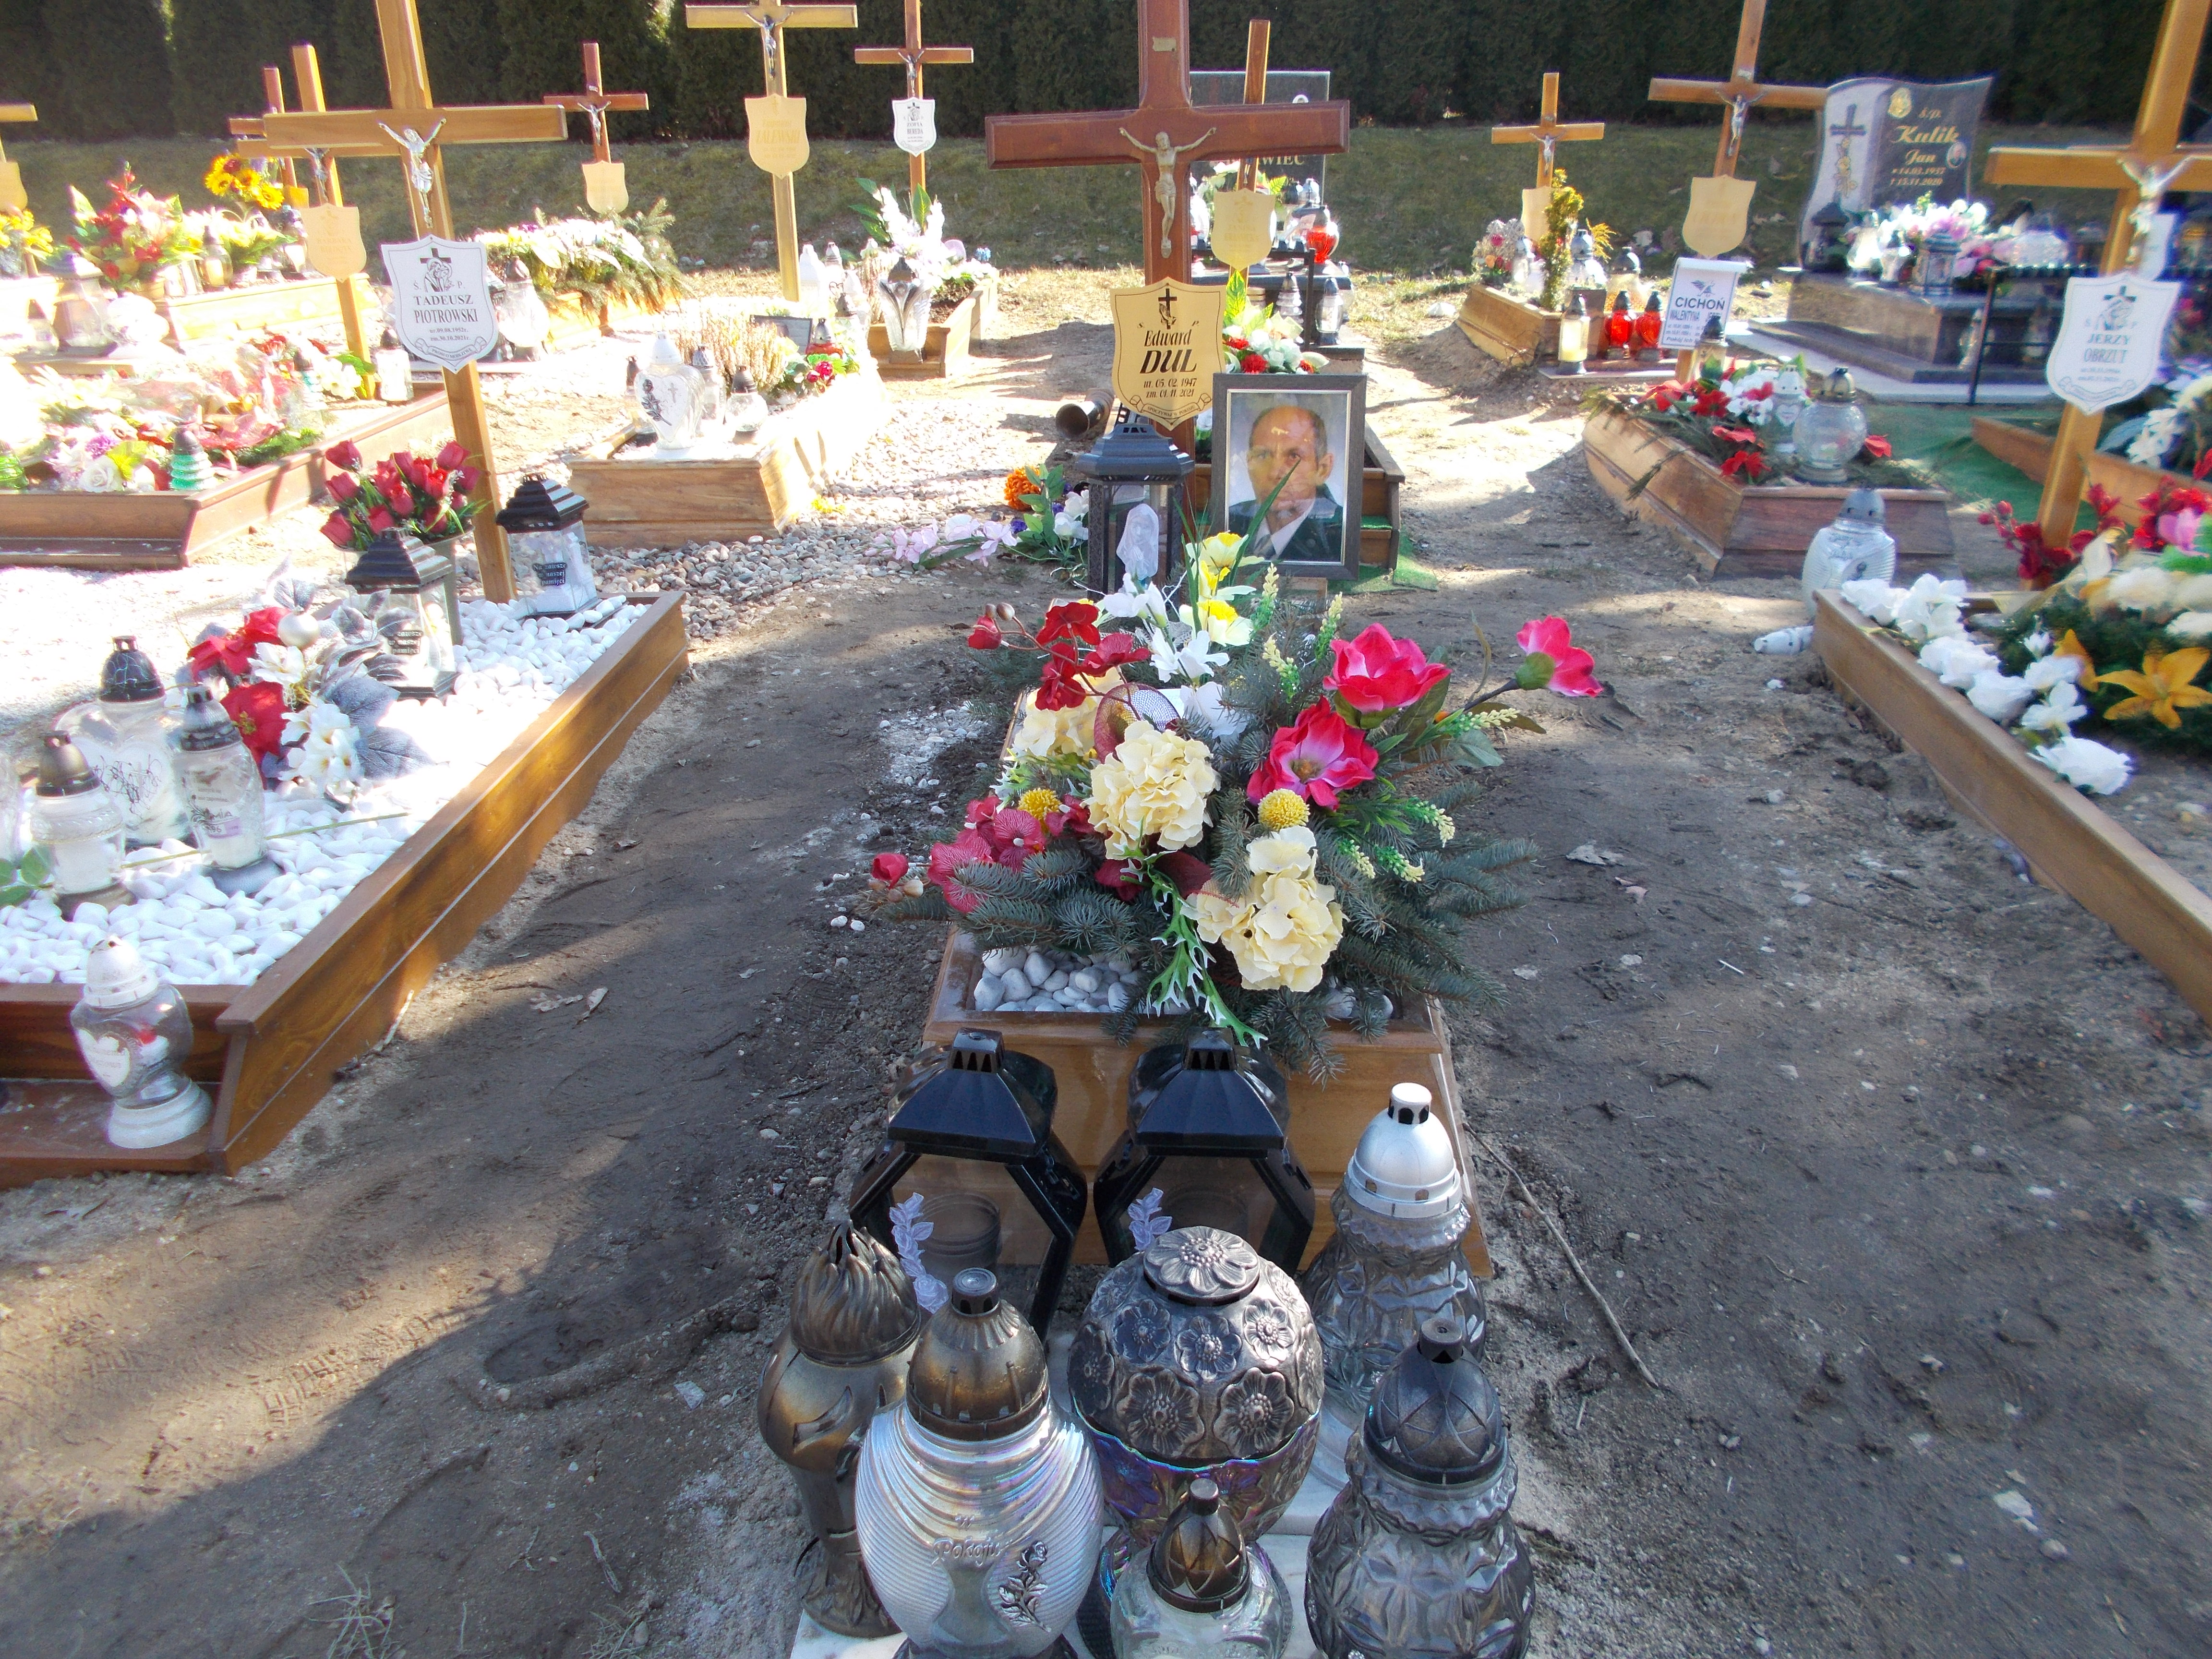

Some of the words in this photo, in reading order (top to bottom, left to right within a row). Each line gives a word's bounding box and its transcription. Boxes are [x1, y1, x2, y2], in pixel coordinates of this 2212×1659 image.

[1889, 125, 1959, 144] Kulik
[1259, 155, 1305, 166] WIEC
[1905, 148, 1936, 166] Jan
[414, 295, 474, 306] TADEUSZ
[1675, 297, 1725, 311] CICHOŃ
[414, 309, 479, 323] PIOTROWSKI
[1144, 329, 1192, 347] Edward
[2087, 333, 2130, 345] JERZY
[1140, 349, 1197, 374] DUL
[1155, 379, 1166, 388] 05.
[1168, 378, 1178, 387] 02.
[1181, 378, 1197, 387] 1947
[1160, 389, 1168, 397] 01.
[1179, 389, 1194, 397] 2021
[931, 1536, 1000, 1567] Pokoju
